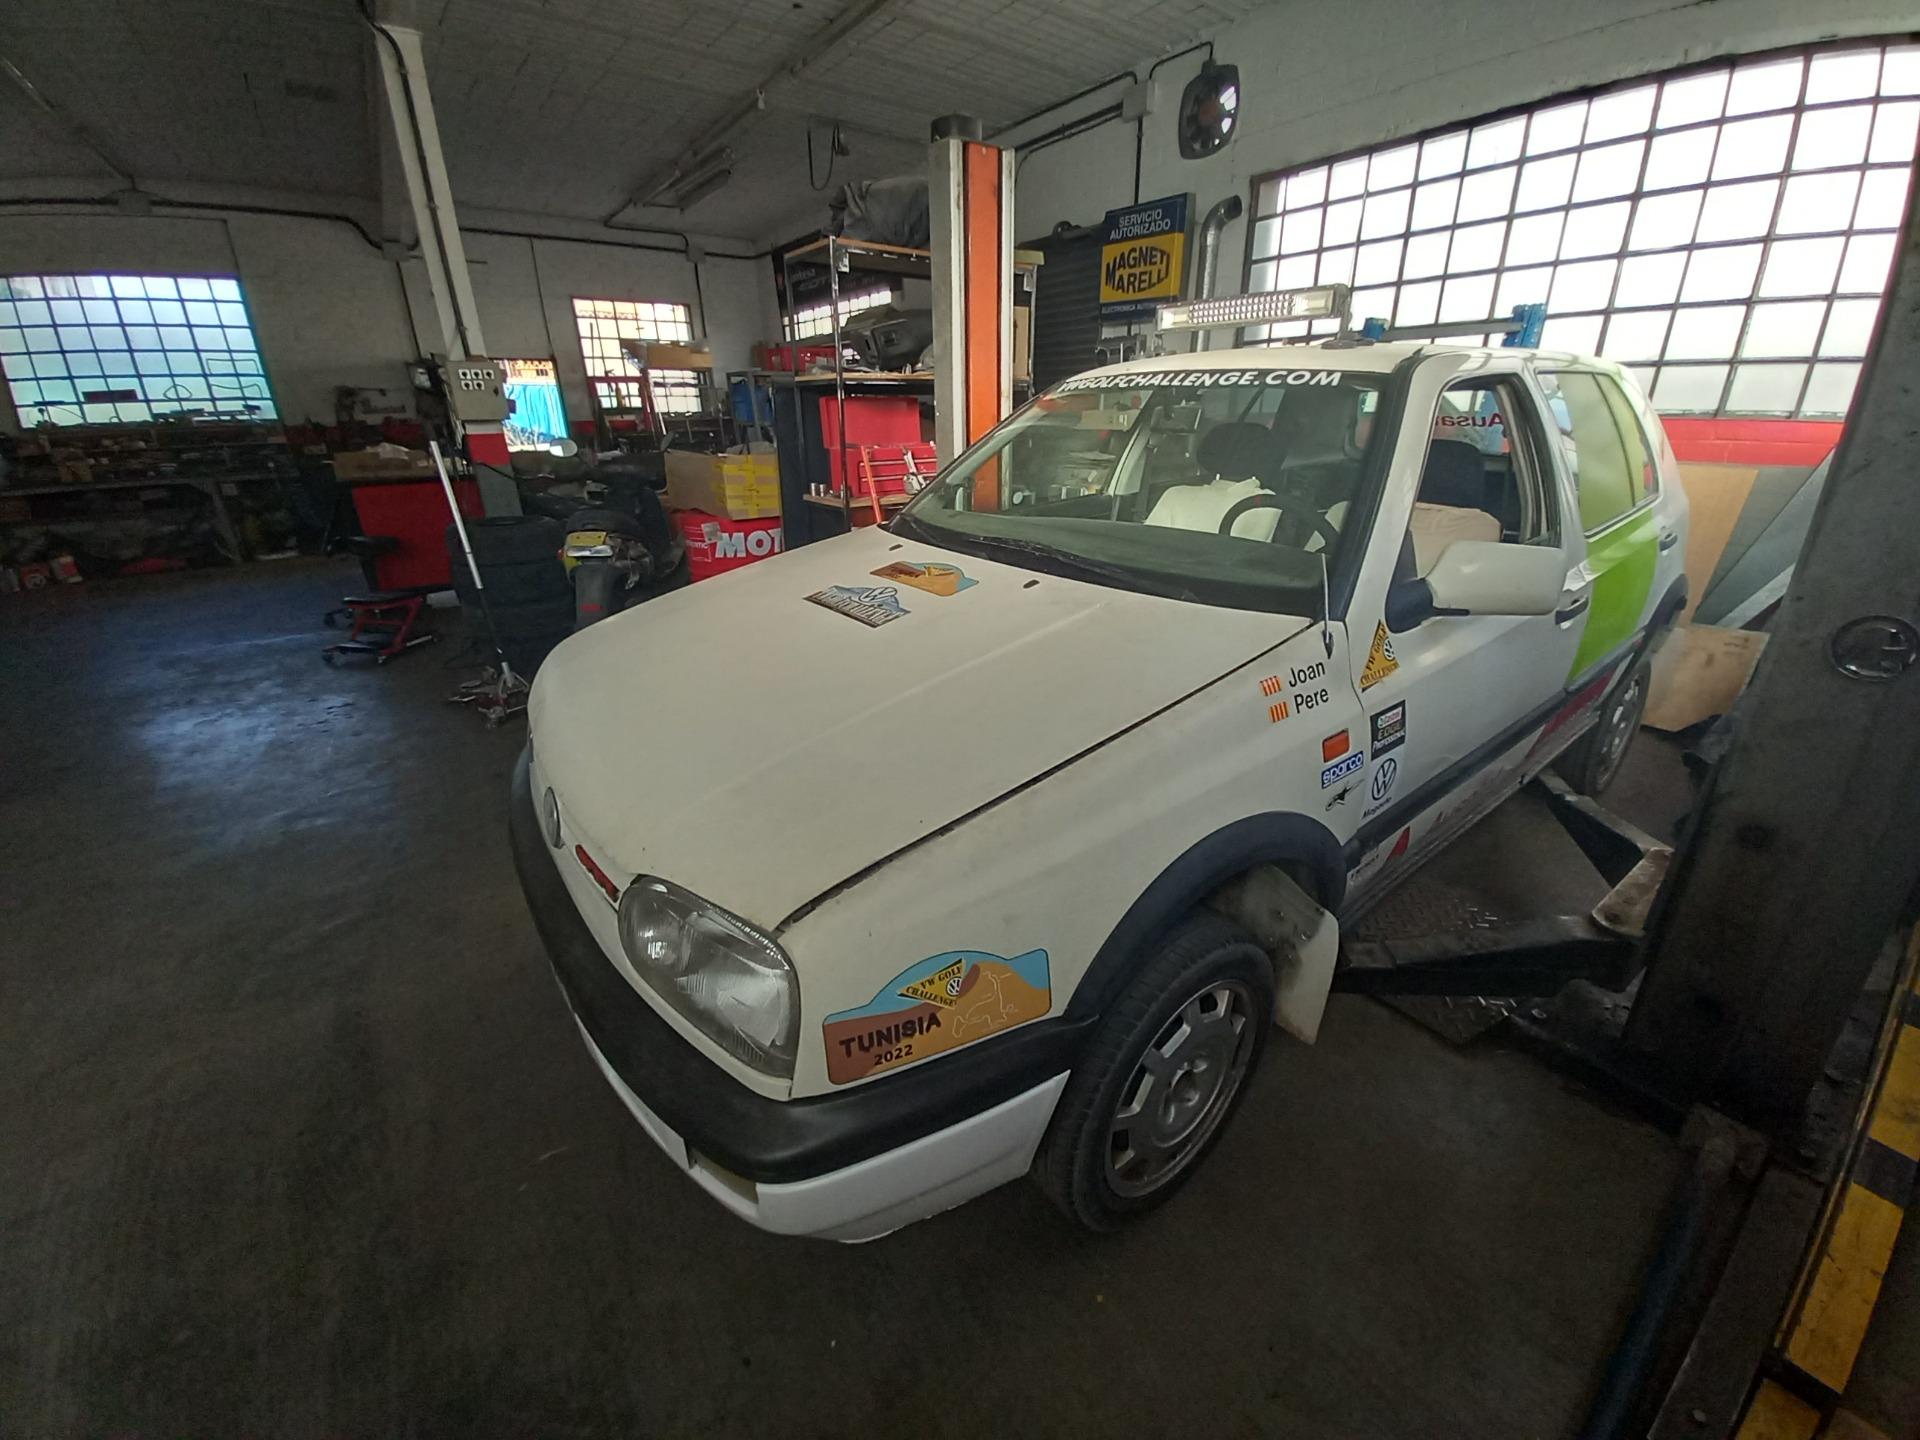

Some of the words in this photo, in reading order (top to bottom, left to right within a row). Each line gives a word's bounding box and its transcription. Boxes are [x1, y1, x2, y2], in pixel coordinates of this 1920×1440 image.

[1109, 219, 1171, 240] AUTORIZADO
[1118, 209, 1162, 227] SERVICIO
[1288, 661, 1326, 688] Joan
[1294, 688, 1329, 714] Pere
[1322, 753, 1363, 785] sparco
[919, 975, 936, 989] VW
[938, 965, 961, 984] GOLF
[905, 985, 958, 1006] CHALLENGE
[839, 1011, 942, 1059] TUNISIA
[873, 1044, 914, 1067] 2022
